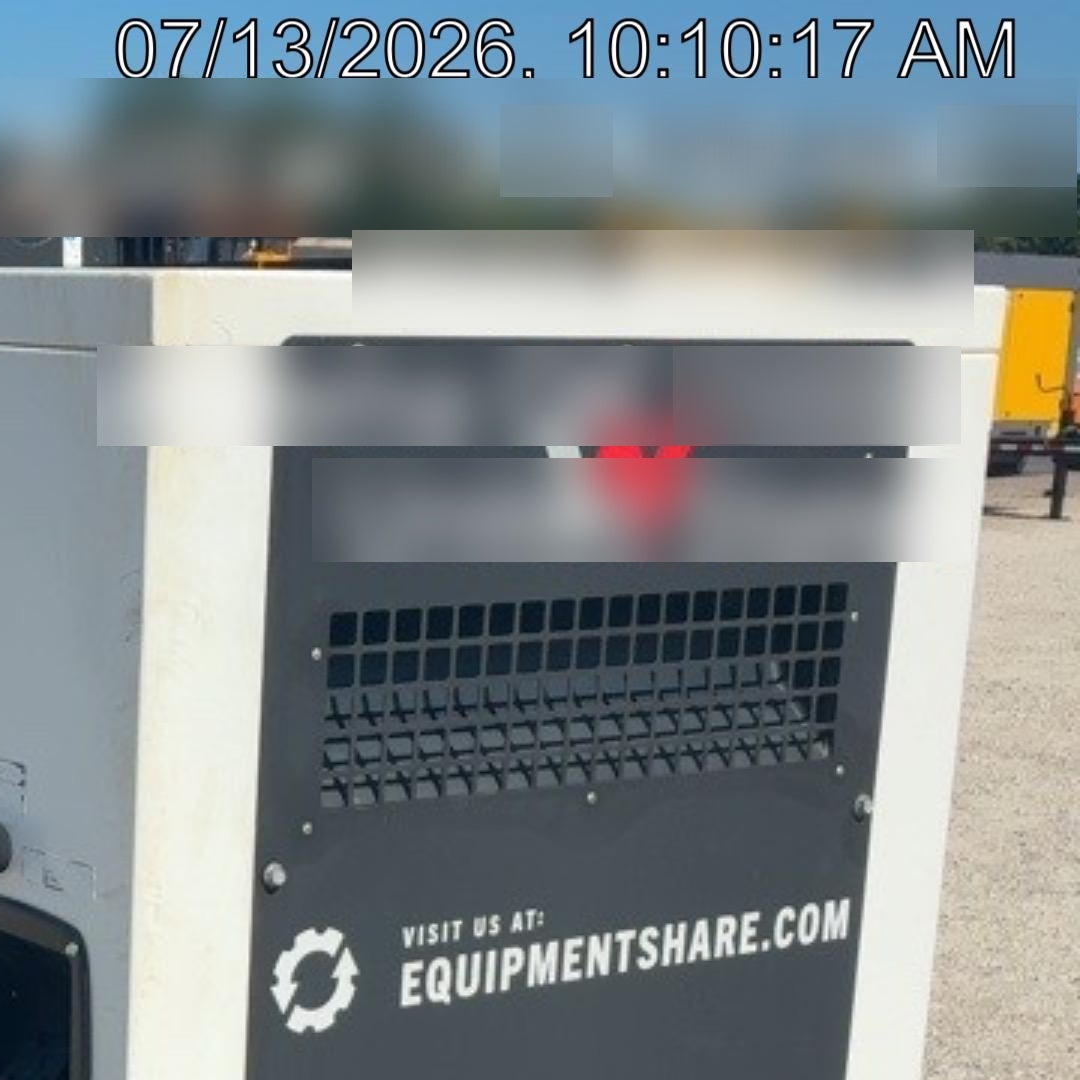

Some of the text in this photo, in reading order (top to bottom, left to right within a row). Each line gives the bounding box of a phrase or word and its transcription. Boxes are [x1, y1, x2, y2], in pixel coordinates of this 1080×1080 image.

[400, 898, 851, 1008] EQUIPMENTSHARE.COM
[402, 908, 545, 949] VISIT US AT:
